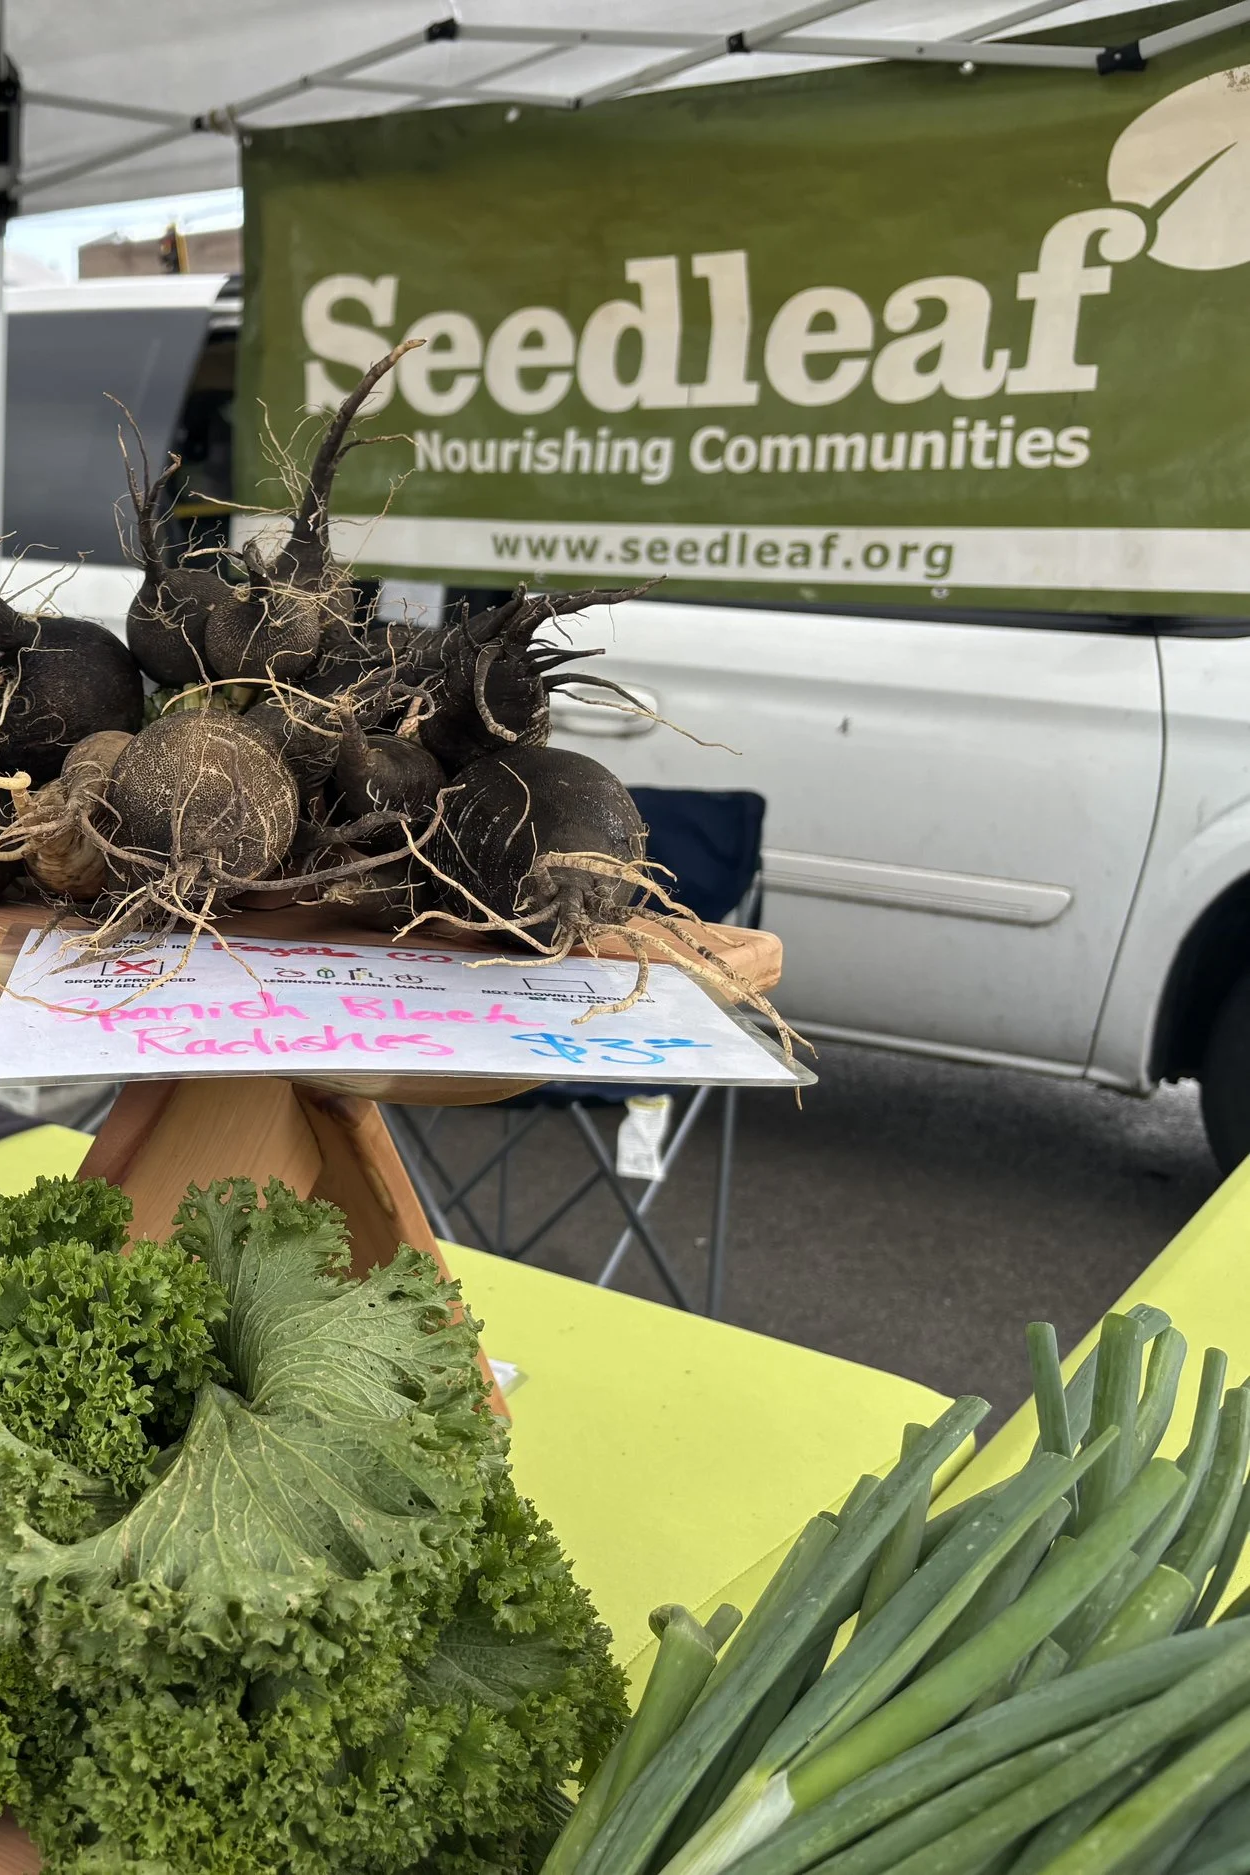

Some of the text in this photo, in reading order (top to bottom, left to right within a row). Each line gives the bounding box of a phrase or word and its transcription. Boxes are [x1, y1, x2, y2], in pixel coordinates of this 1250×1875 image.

[301, 207, 1147, 417] Seedleaf
[414, 415, 1091, 486] Nourishing Communities
[491, 531, 956, 580] www.seedleaf.org
[47, 991, 547, 1032] Spanish Black
[577, 995, 656, 1003] PRODUED
[132, 1024, 454, 1056] Radishes
